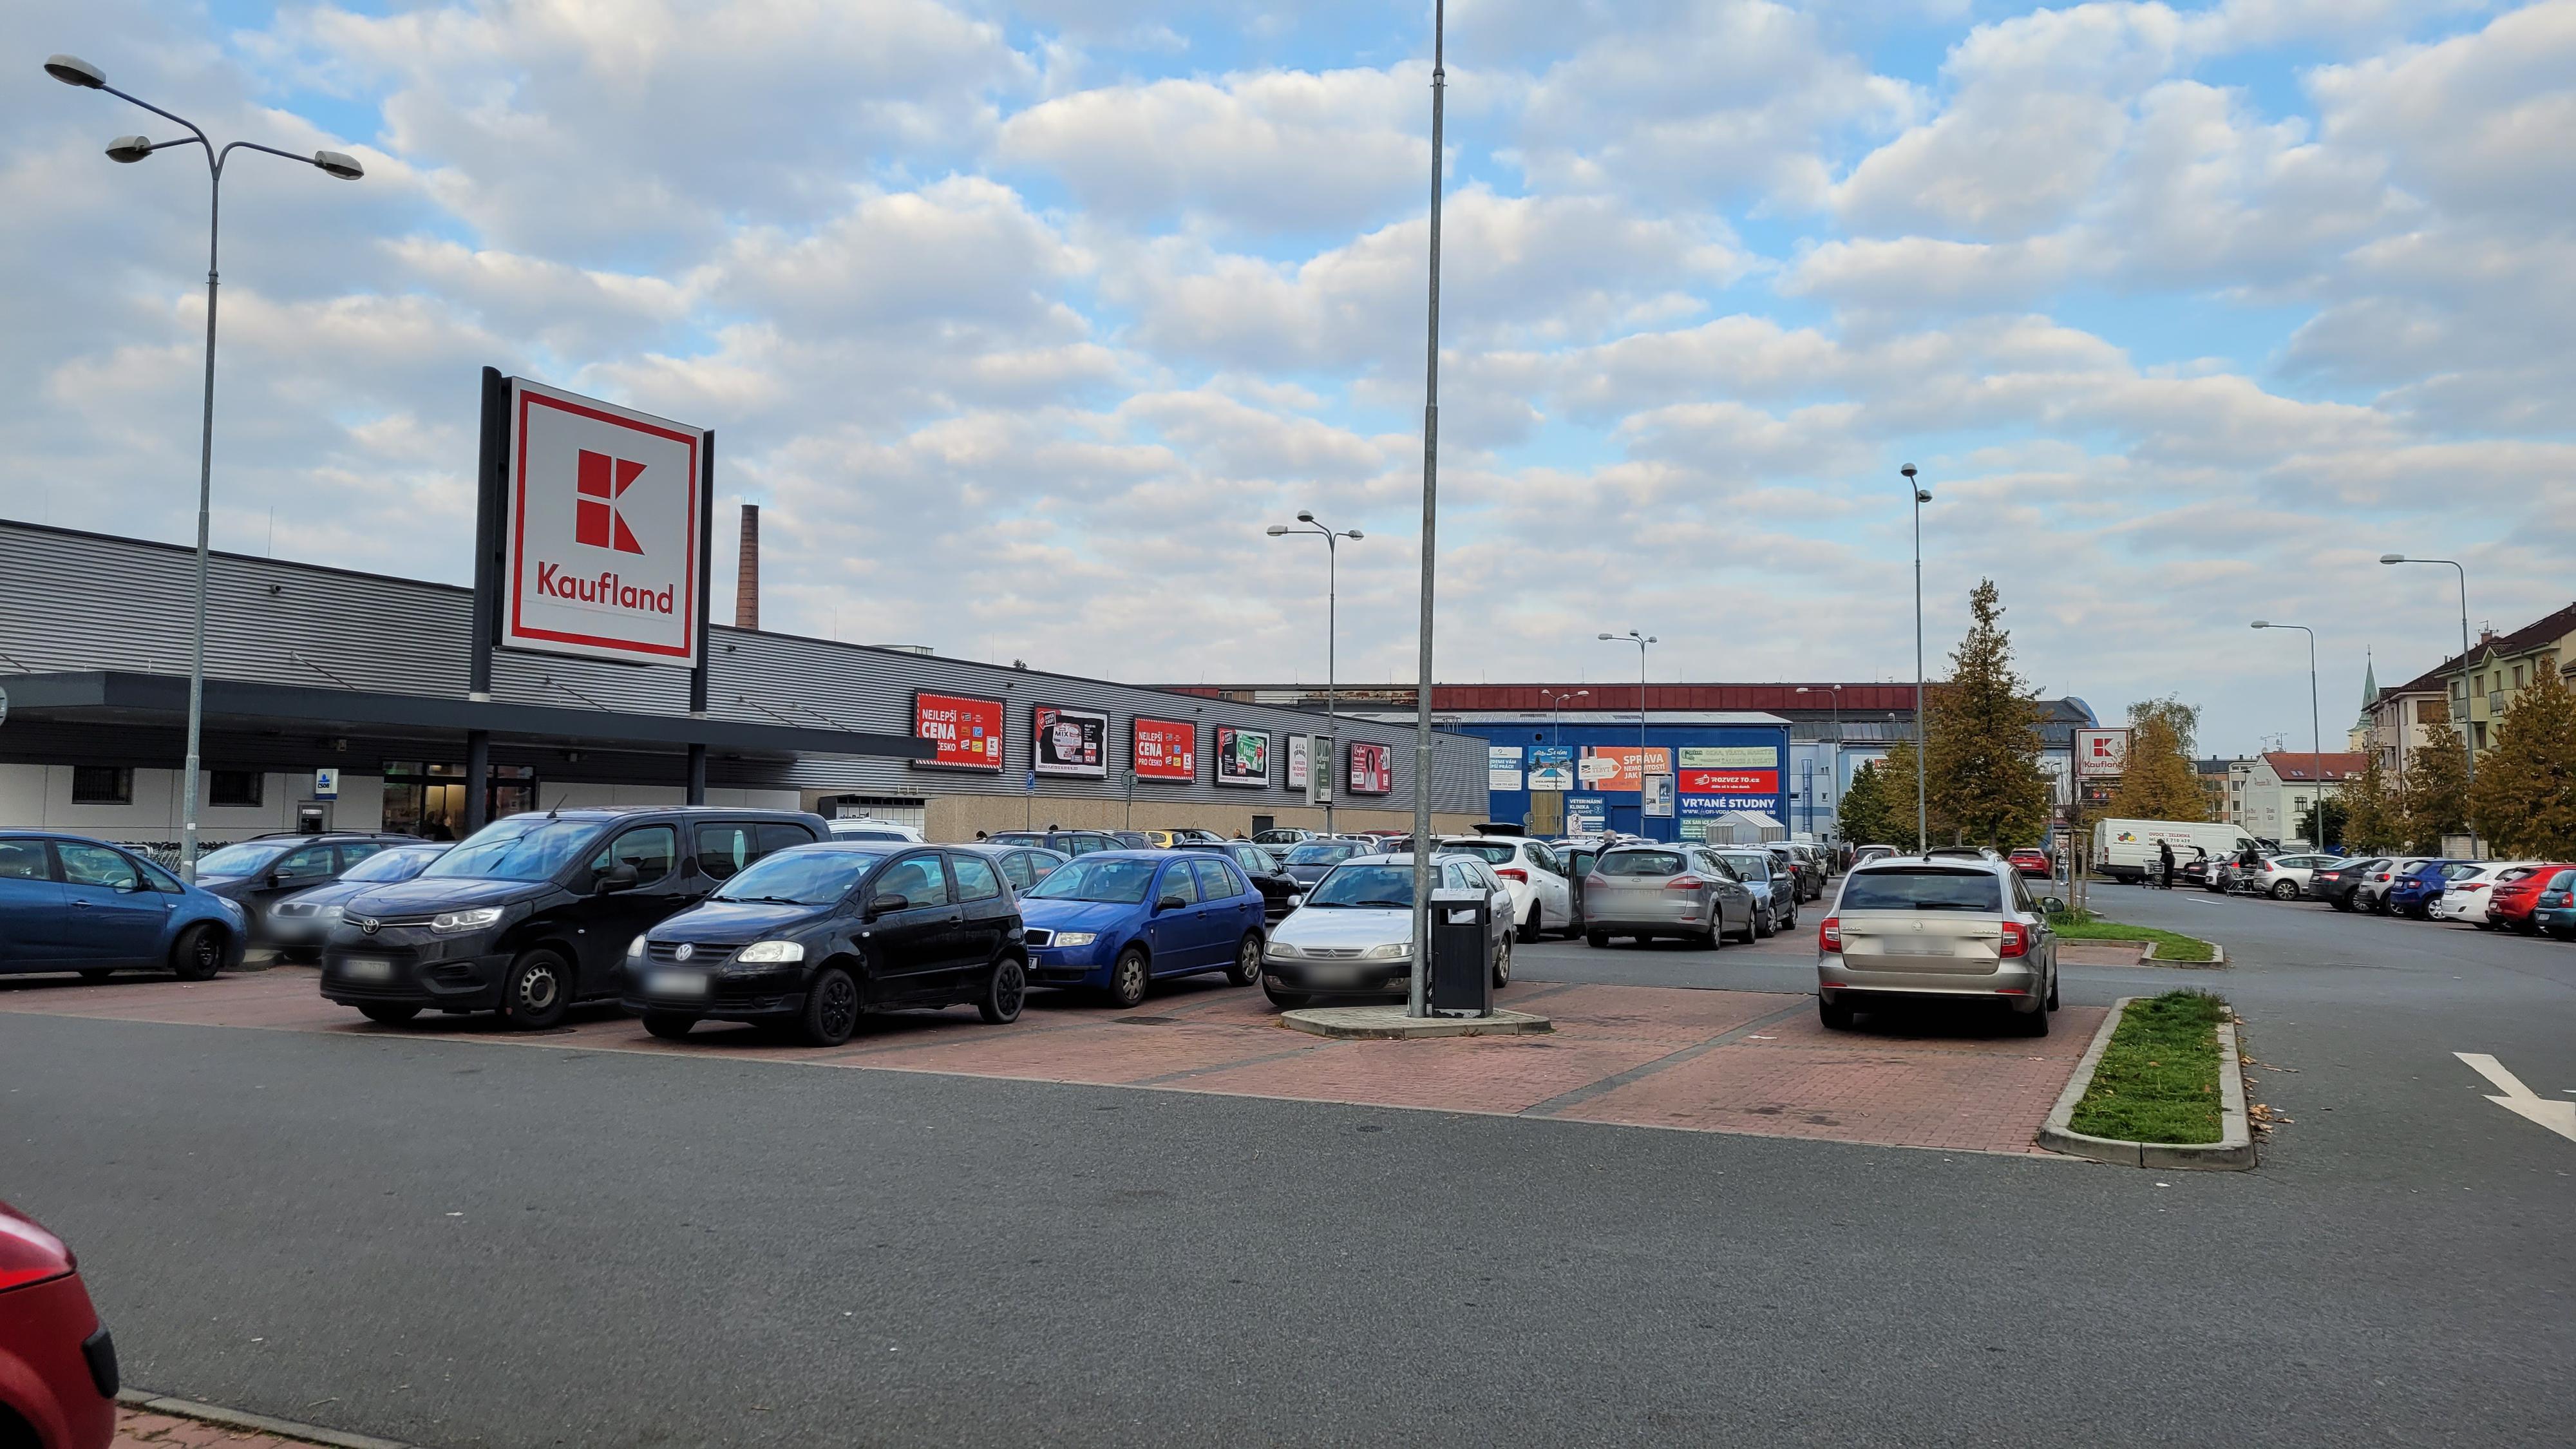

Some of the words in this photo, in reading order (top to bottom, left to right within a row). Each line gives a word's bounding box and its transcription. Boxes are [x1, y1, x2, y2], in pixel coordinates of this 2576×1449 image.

[536, 561, 674, 614] Kaufland
[922, 708, 957, 722] NEJLEPŠÍ
[922, 721, 956, 740] CENA
[1139, 732, 1162, 742] NEJLEPŠÍ
[1139, 742, 1162, 757] CENA
[1148, 758, 1162, 766] ČESKO
[1624, 753, 1664, 764] SPRÁVA
[1028, 773, 1033, 781] P
[1682, 797, 1727, 808] VRTANÉ
[1728, 799, 1776, 808] STUDNY
